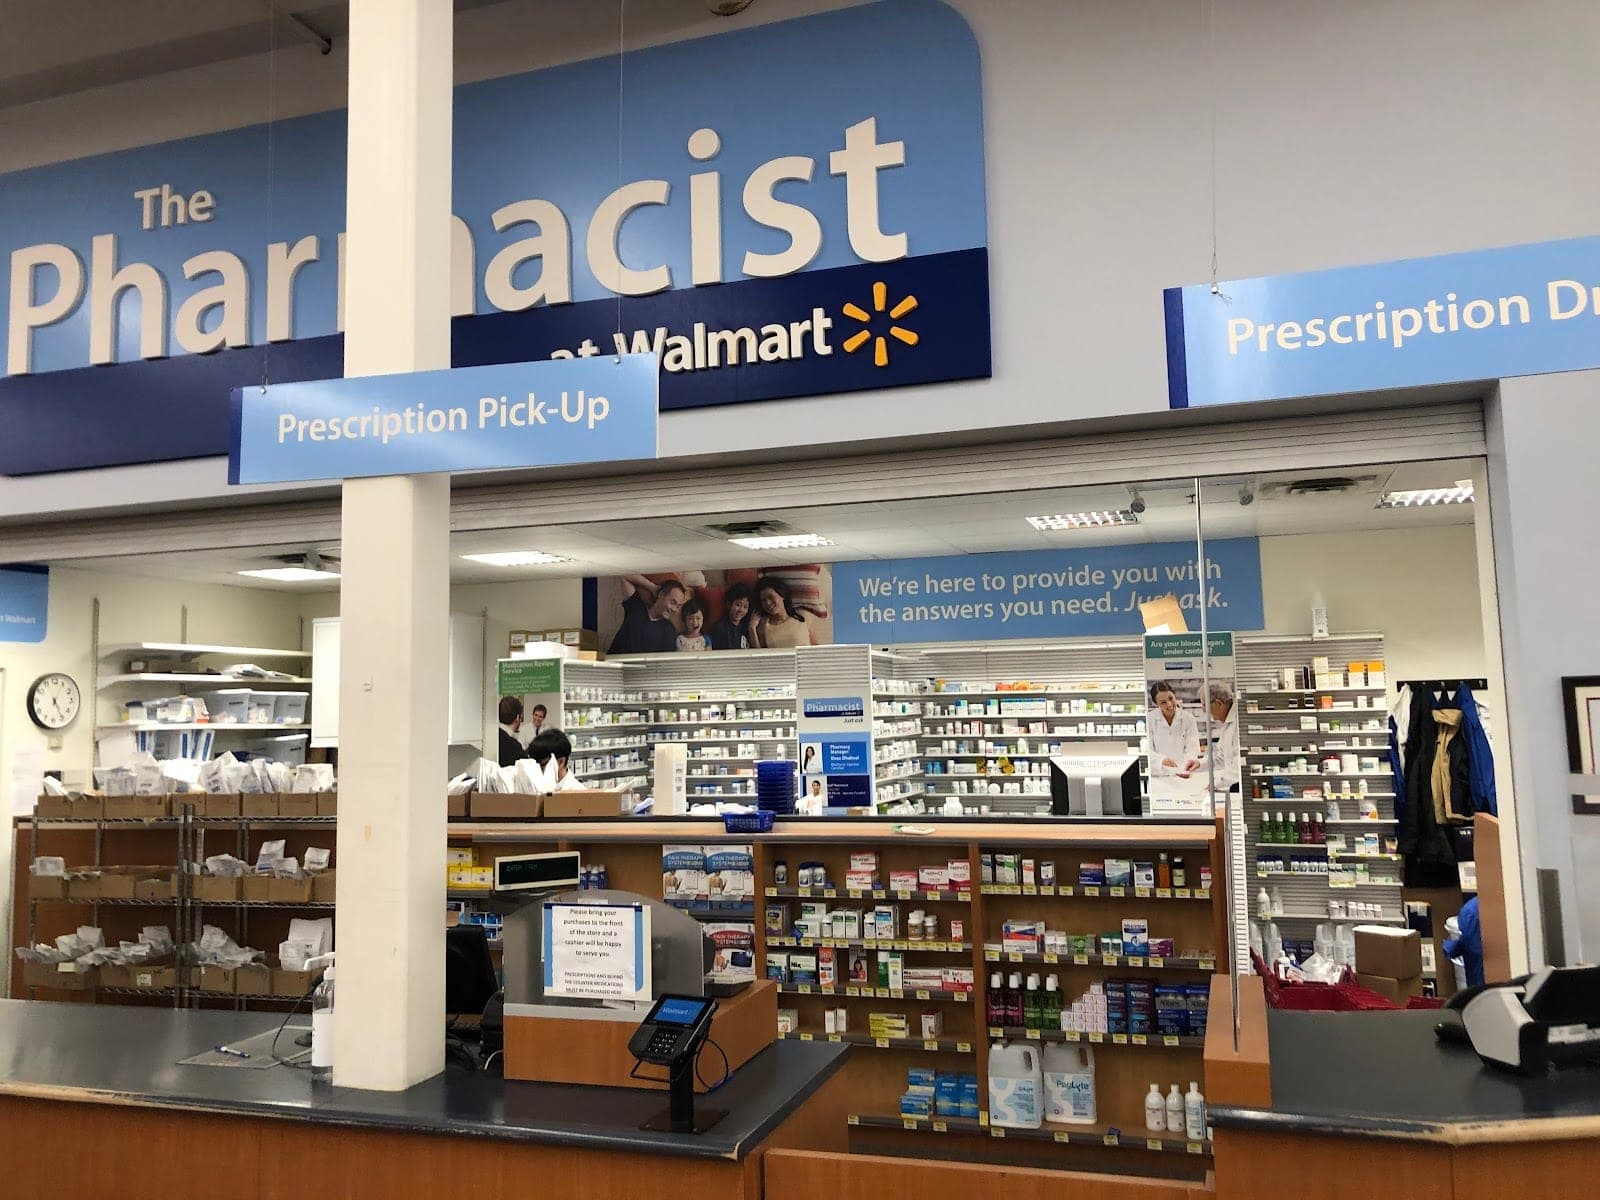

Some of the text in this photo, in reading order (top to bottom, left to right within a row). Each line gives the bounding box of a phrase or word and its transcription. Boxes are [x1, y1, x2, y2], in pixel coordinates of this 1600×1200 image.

[134, 184, 216, 230] The
[8, 116, 908, 375] Pharacist
[1227, 292, 1531, 355] Prescription
[613, 307, 833, 373] Walmart
[277, 389, 610, 445] Prescription Pick-Up
[858, 576, 919, 597] We're
[925, 574, 976, 594] here
[981, 573, 1006, 591] to
[1012, 565, 1105, 595] provide
[1111, 567, 1158, 590] you
[859, 603, 896, 624] the
[902, 602, 994, 621] answers
[999, 600, 1044, 623] you
[1051, 591, 1119, 615] need.
[1124, 591, 1172, 612] Ju
[1163, 641, 1180, 649] your
[806, 702, 860, 712] Pharmacist
[609, 919, 623, 927] front
[604, 940, 622, 948] happy
[1056, 1079, 1089, 1092] PegLyte
